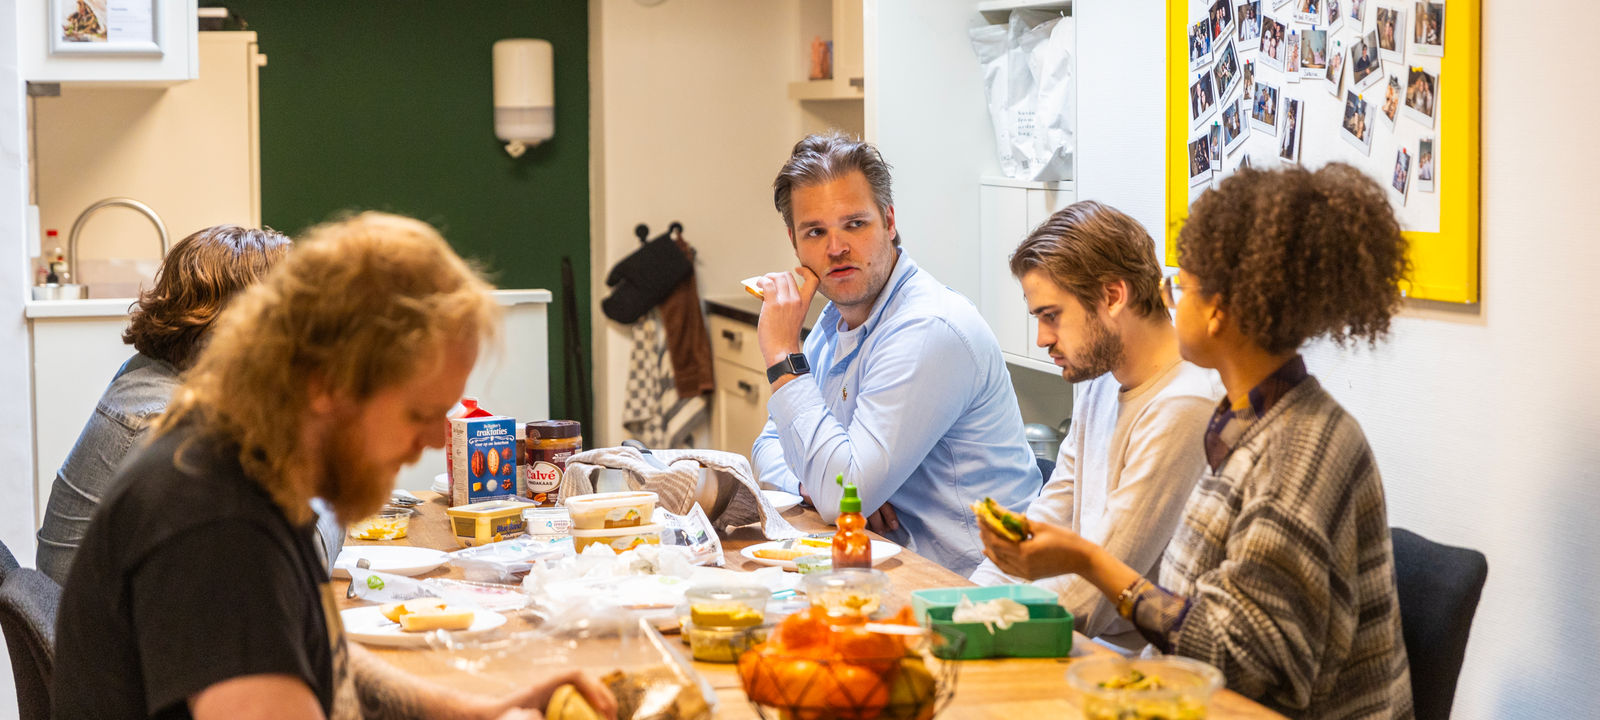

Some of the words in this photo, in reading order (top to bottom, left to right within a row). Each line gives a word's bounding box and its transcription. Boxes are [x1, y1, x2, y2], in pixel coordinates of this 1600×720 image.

[476, 428, 508, 437] traktaties
[527, 469, 555, 480] Calvé
[496, 524, 508, 533] Blue
